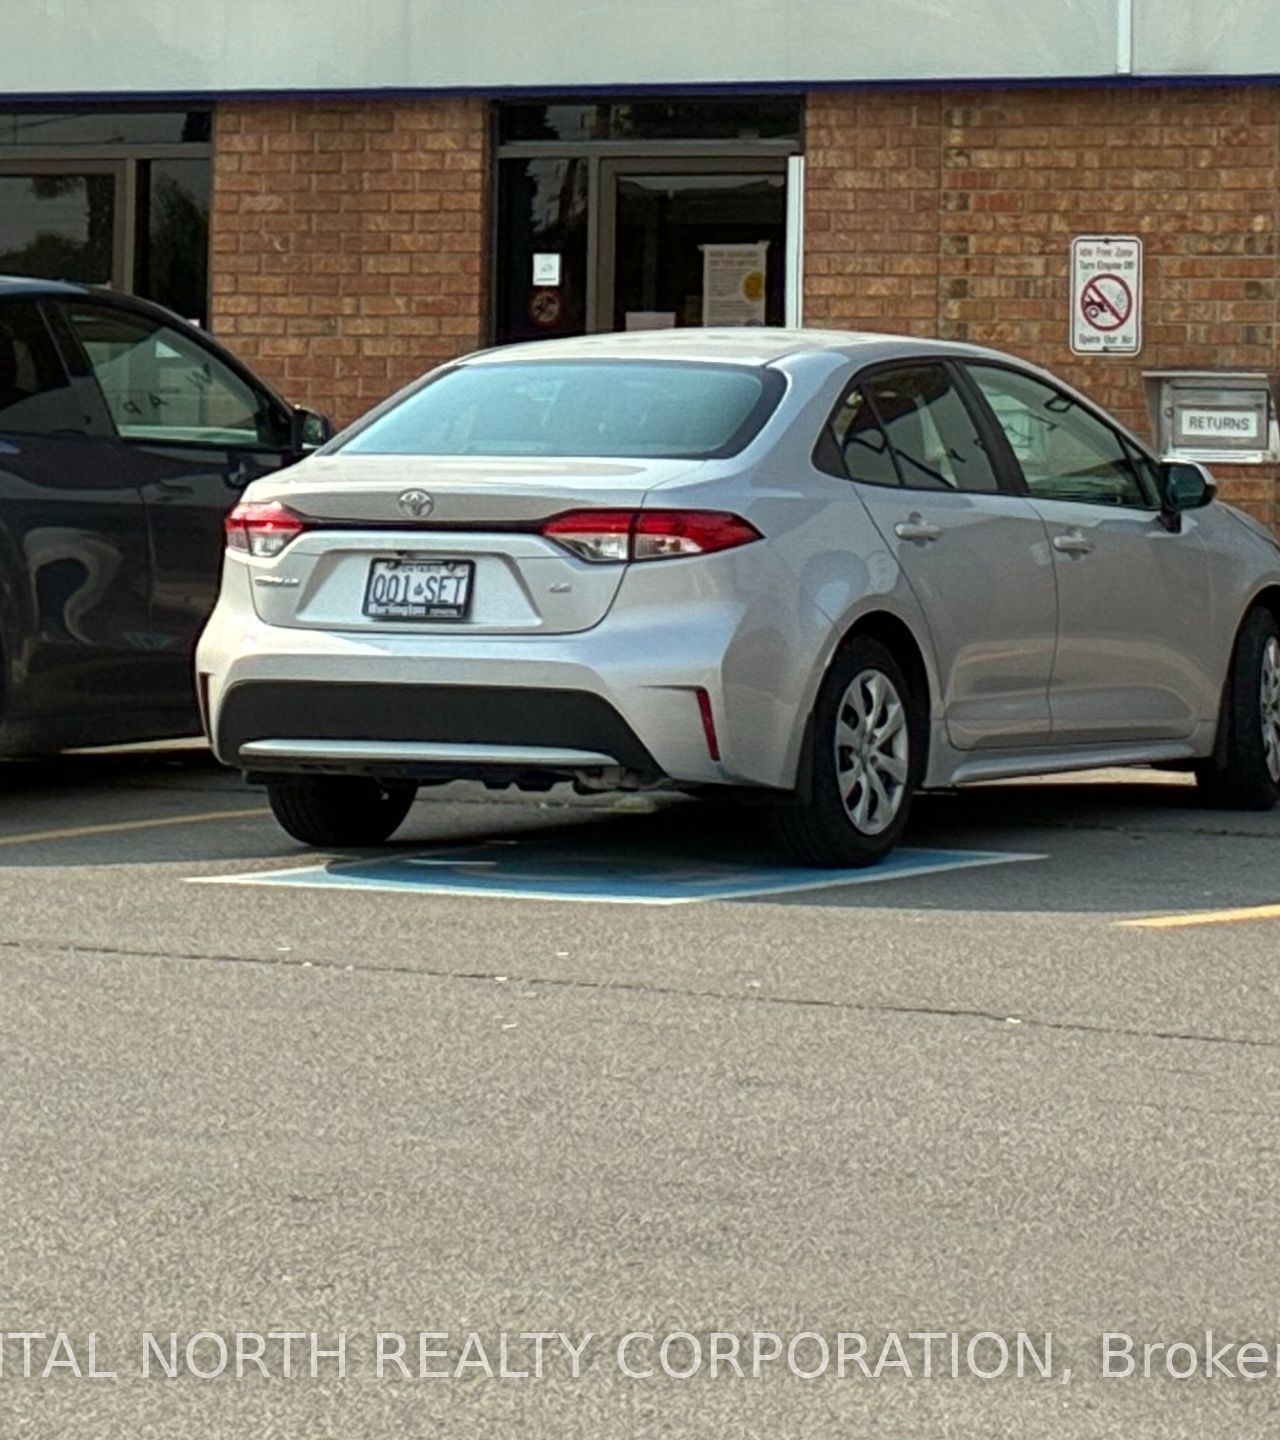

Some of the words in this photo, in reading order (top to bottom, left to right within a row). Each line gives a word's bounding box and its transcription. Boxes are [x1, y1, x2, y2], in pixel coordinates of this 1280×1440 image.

[1189, 416, 1250, 431] RETURNS
[373, 573, 411, 606] 001
[424, 575, 466, 605] SET
